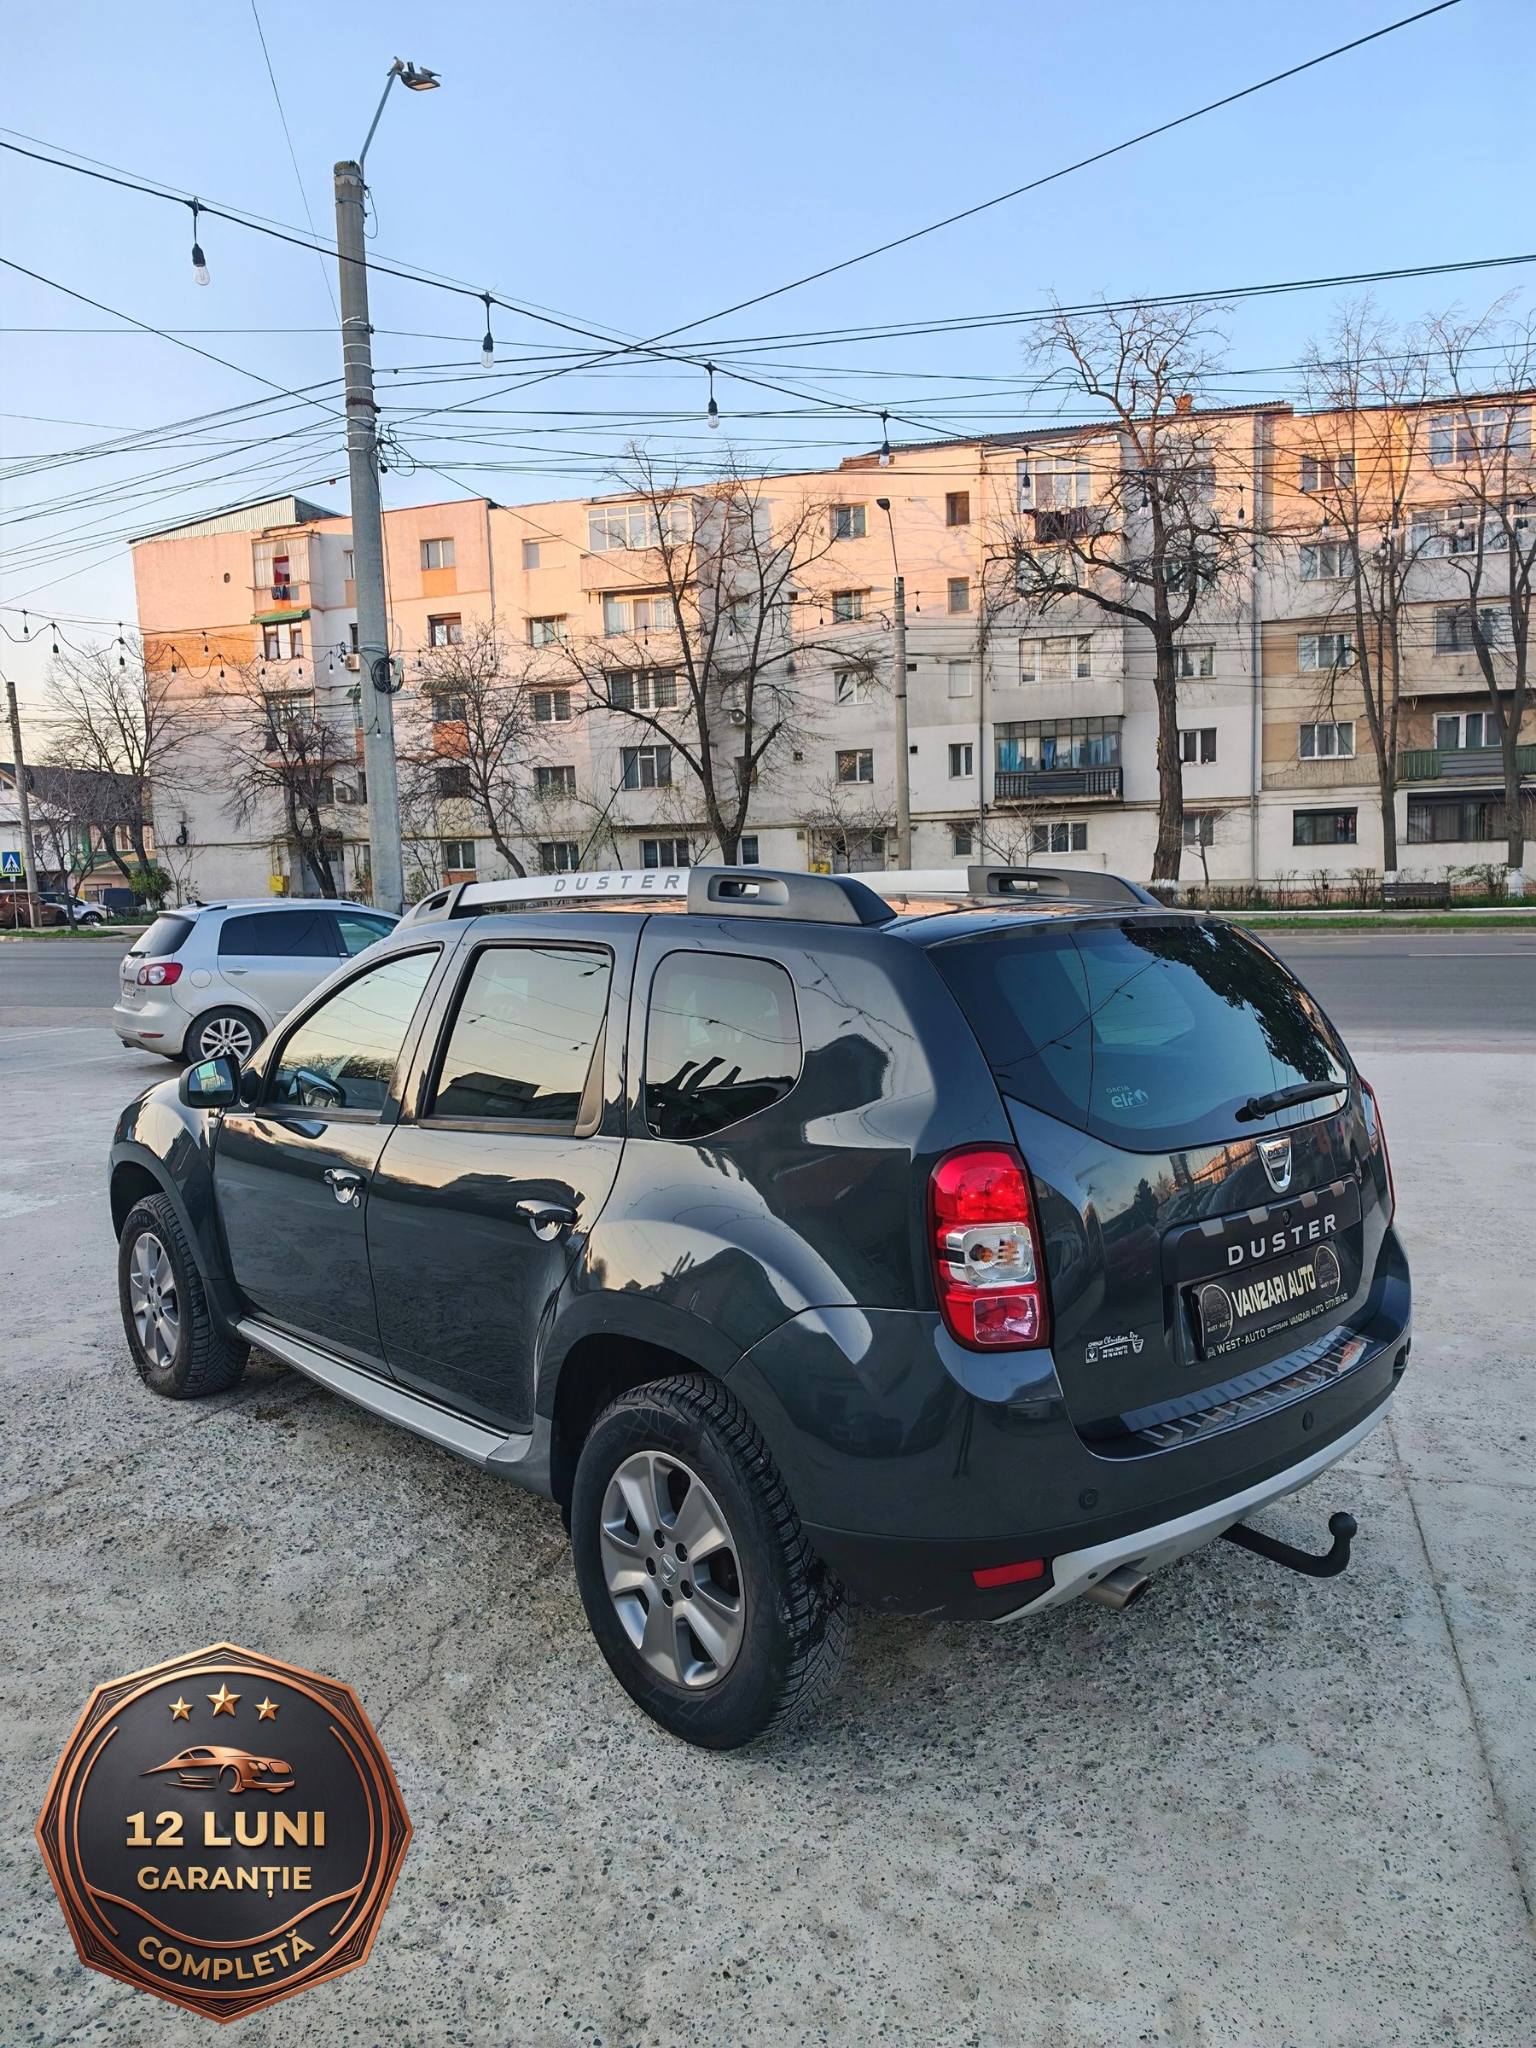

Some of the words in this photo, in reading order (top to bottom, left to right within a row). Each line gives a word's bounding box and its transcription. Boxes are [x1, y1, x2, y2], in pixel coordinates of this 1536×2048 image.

[553, 874, 680, 892] DUSTER
[1227, 1213, 1337, 1266] DUSTER
[1231, 1274, 1288, 1318] VANZARI
[1288, 1263, 1317, 1301] AUTO
[1217, 1328, 1266, 1354] WEST-AUTO
[1311, 1303, 1325, 1316] AUTO
